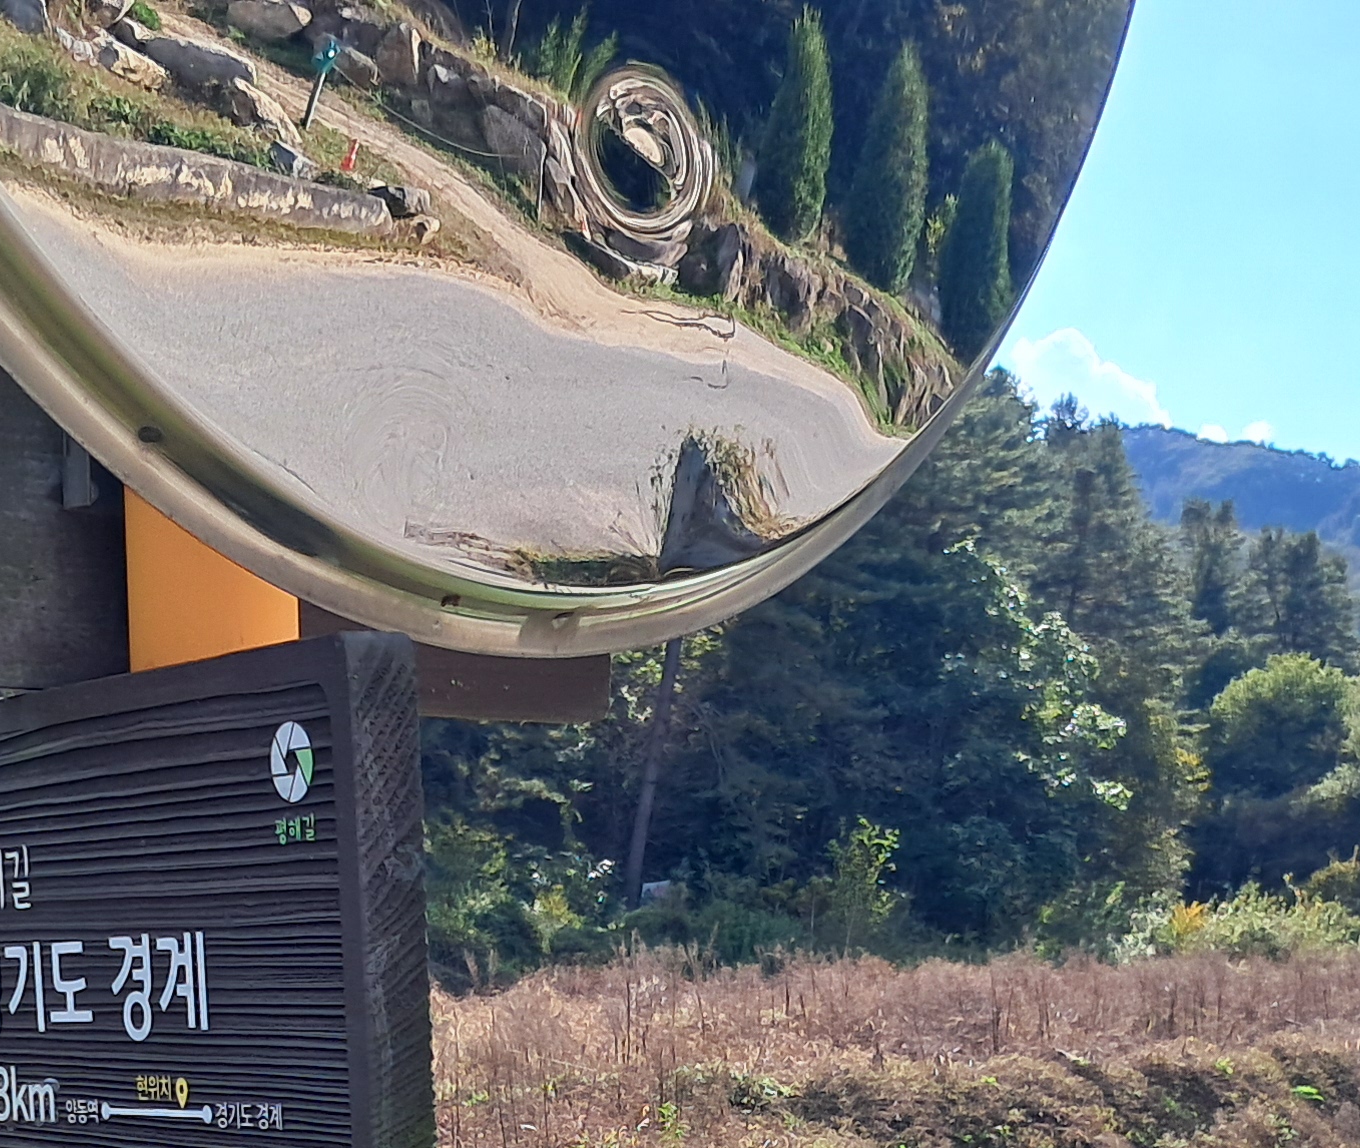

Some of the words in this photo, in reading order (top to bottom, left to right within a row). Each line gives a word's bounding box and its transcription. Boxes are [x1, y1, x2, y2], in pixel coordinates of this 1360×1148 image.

[274, 812, 316, 846] 평해길
[107, 931, 210, 1042] 경계
[136, 1074, 172, 1101] 현위치
[215, 1102, 253, 1129] 경기도
[256, 1102, 283, 1131] 경계
